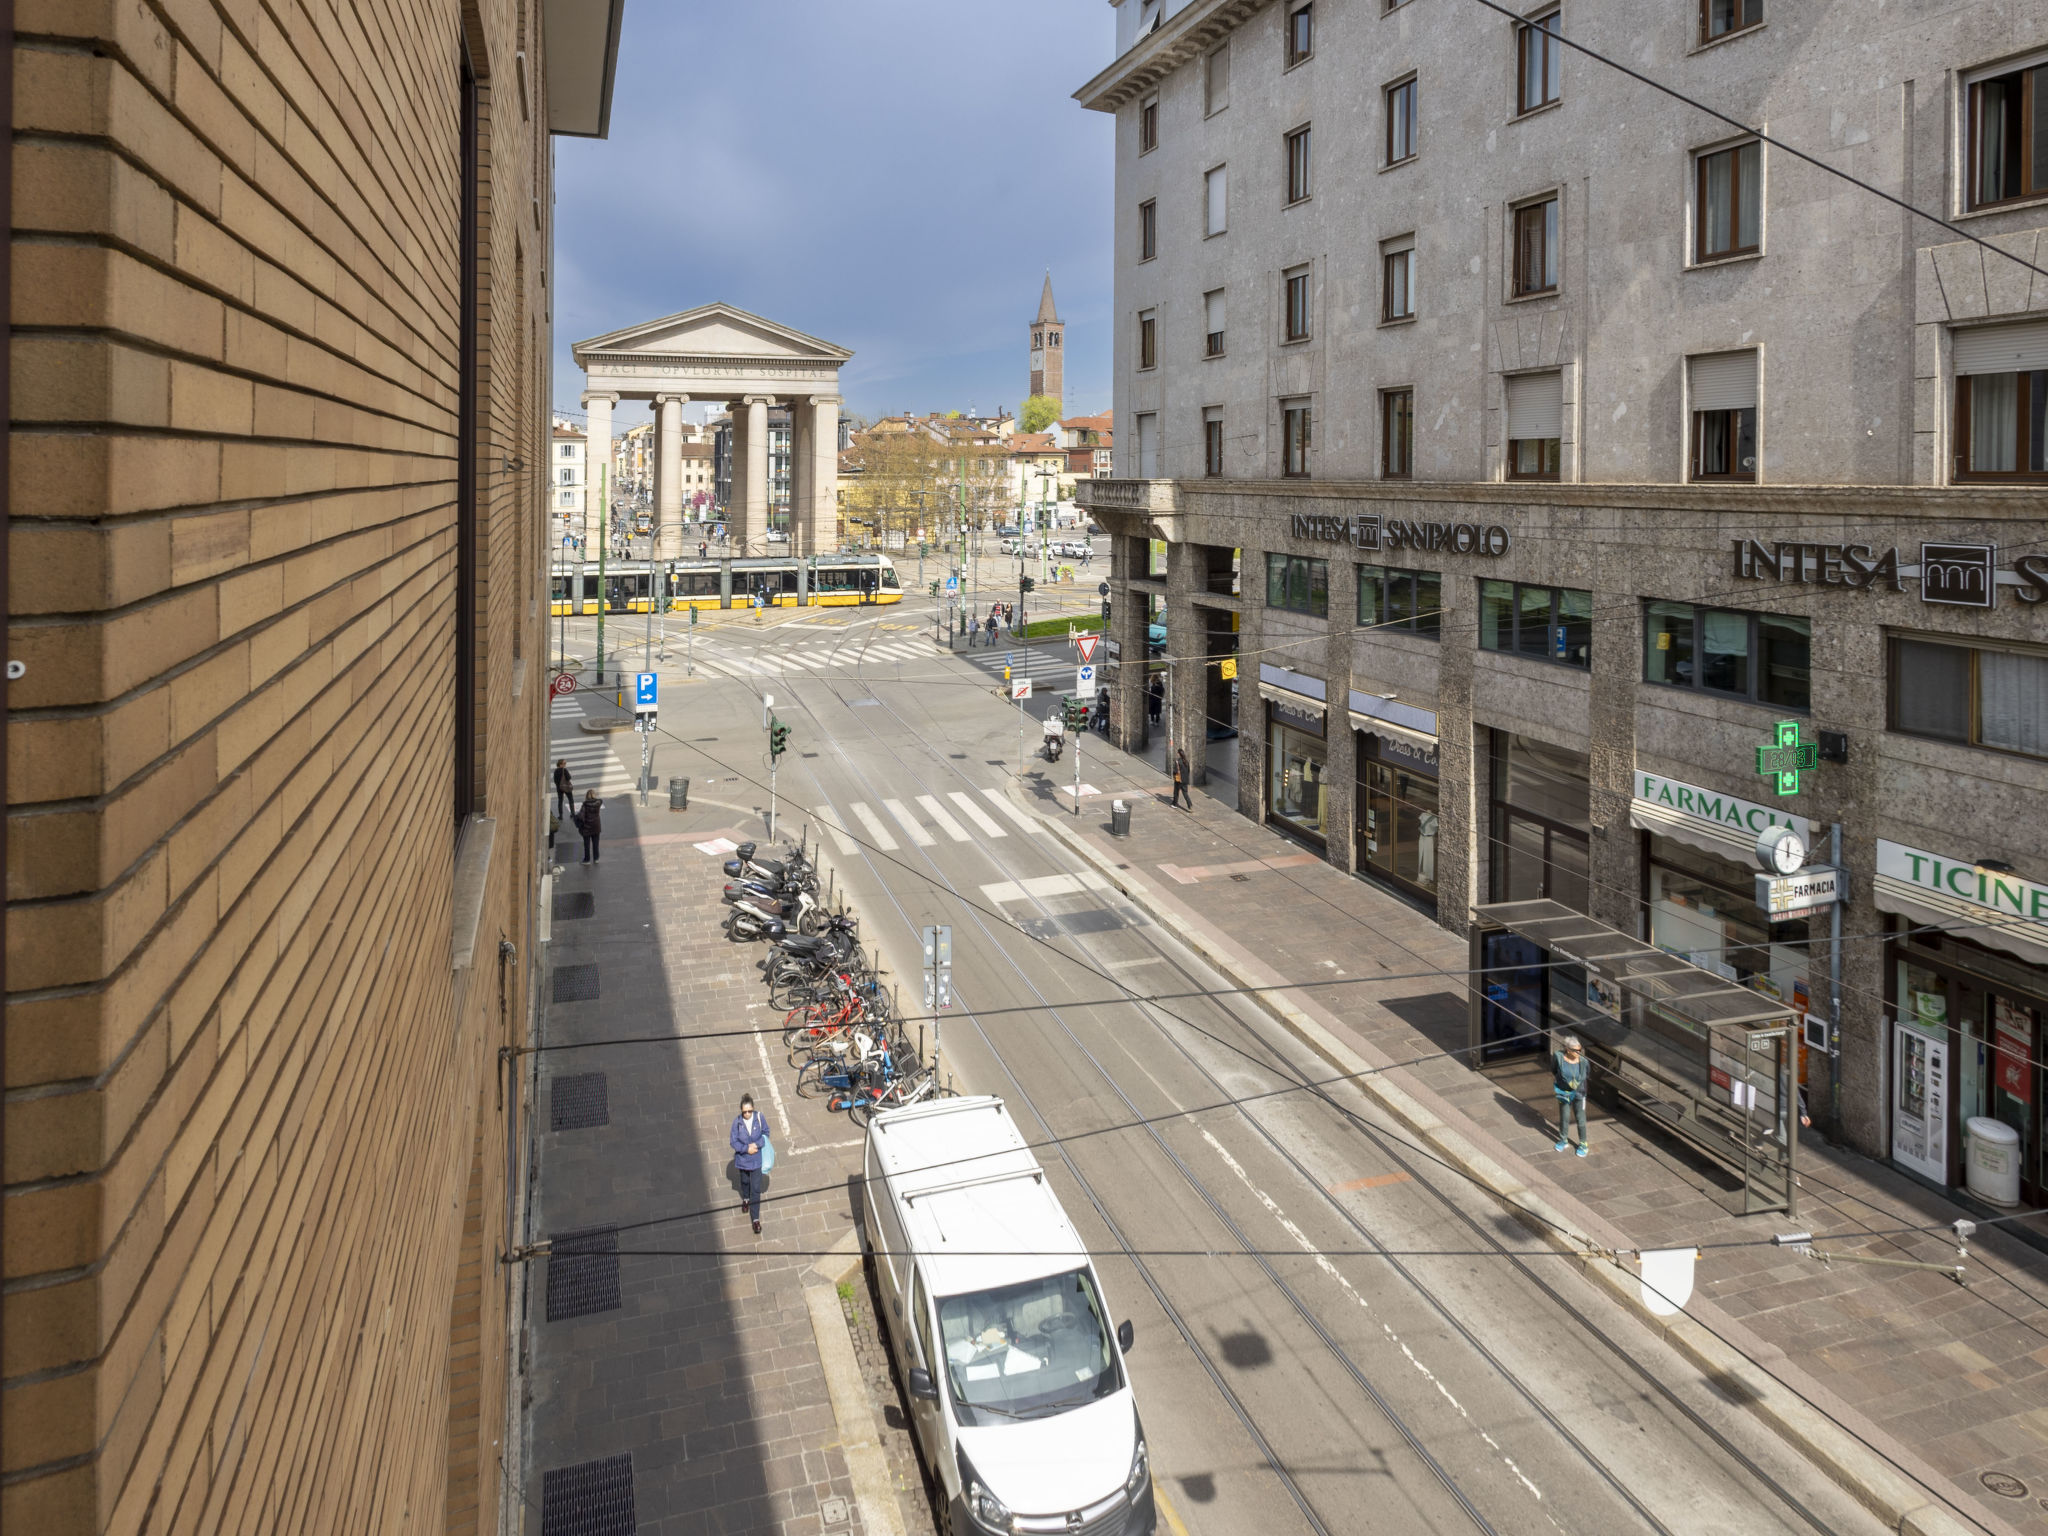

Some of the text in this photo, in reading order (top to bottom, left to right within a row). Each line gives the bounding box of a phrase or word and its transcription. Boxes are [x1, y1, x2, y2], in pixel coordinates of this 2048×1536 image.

[602, 363, 637, 373] PACI
[759, 367, 826, 378] SOSPITAE
[1291, 514, 1510, 556] INTESA SANPAOLO
[1732, 539, 1906, 592] INTESA
[559, 681, 571, 689] 24
[641, 674, 653, 691] P
[1770, 749, 1806, 769] 28/03
[1794, 880, 1835, 898] FARMACIA
